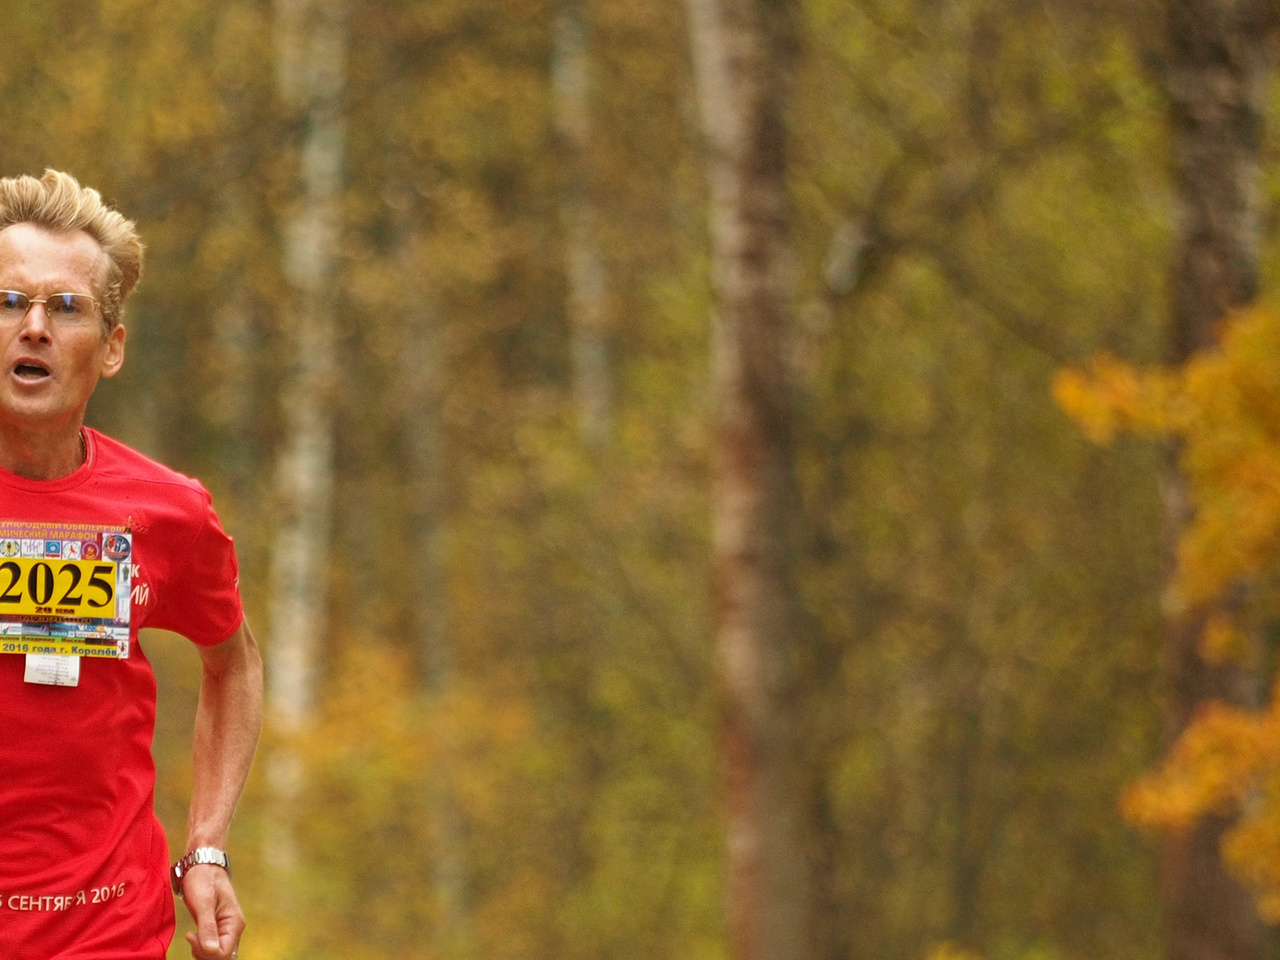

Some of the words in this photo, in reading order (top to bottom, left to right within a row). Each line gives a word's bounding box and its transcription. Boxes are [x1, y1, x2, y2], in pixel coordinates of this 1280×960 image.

[49, 531, 98, 541] МАРАФОН
[2, 643, 30, 652] 2016
[32, 646, 57, 655] года
[71, 645, 118, 656] Королёв
[7, 889, 87, 912] СЕНТЯБЯ
[90, 881, 126, 904] 2016
